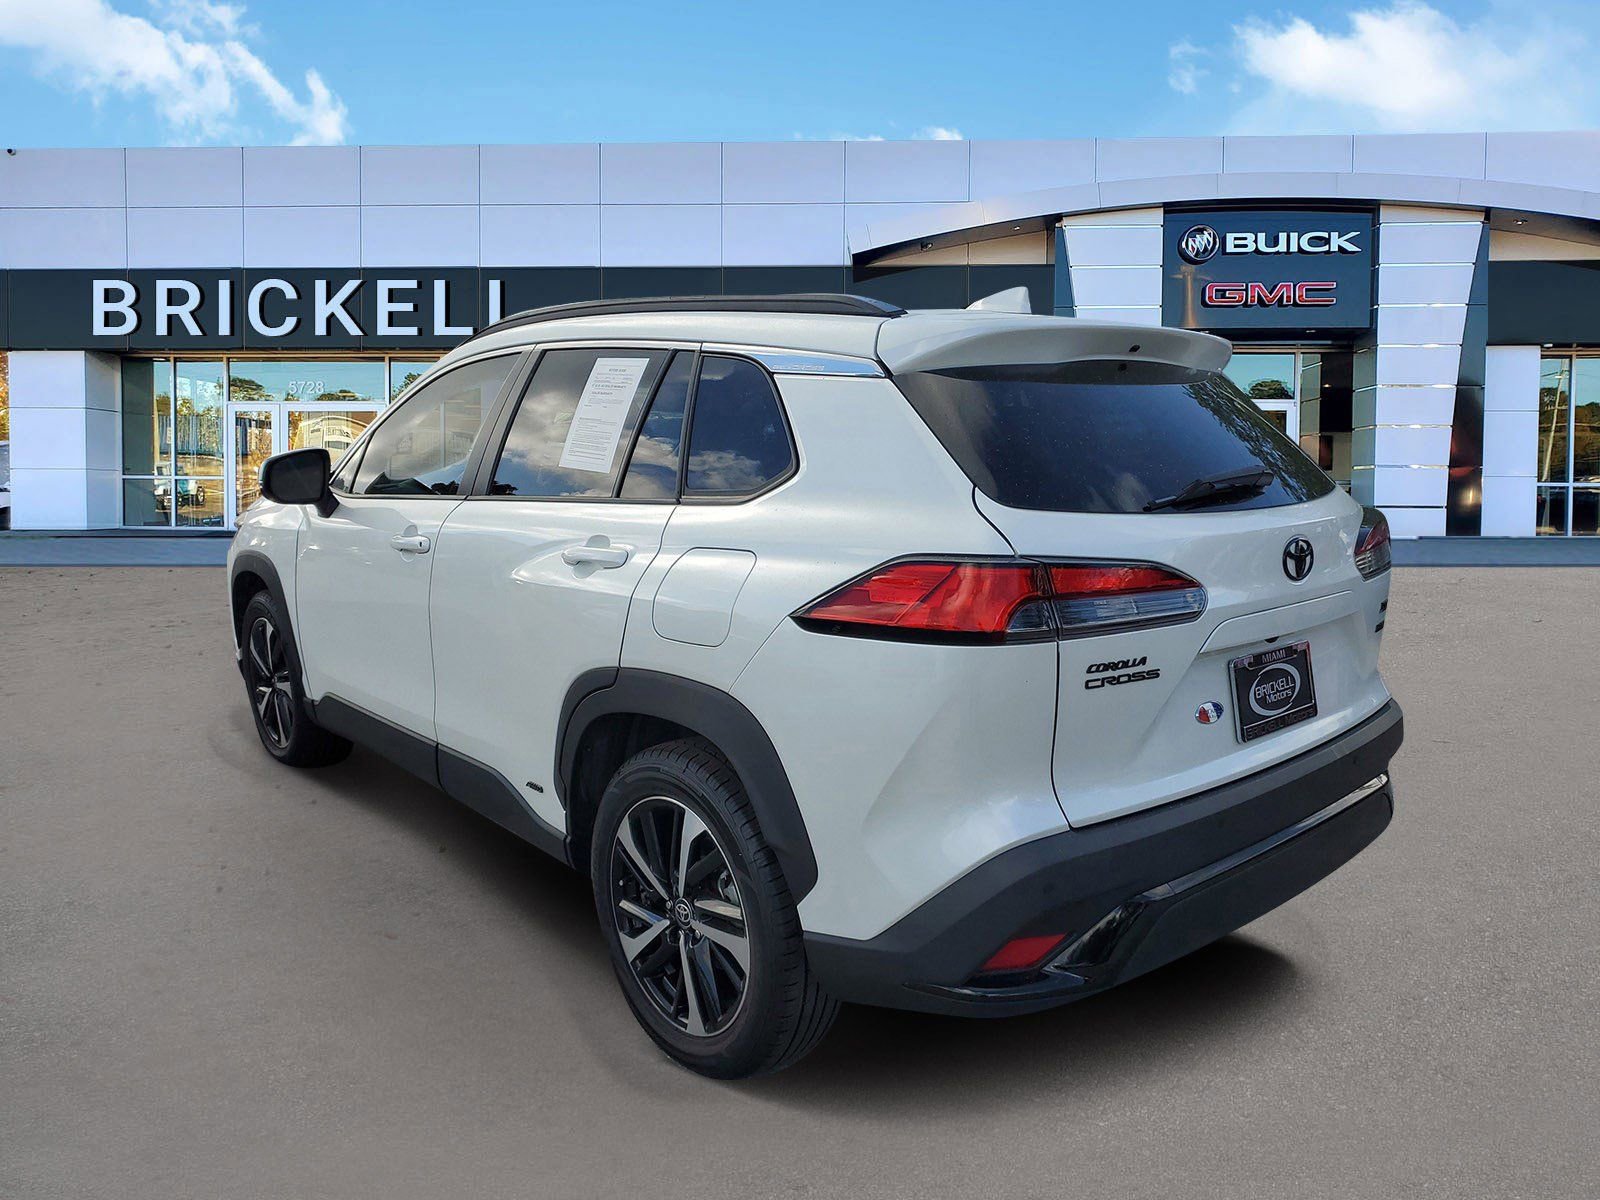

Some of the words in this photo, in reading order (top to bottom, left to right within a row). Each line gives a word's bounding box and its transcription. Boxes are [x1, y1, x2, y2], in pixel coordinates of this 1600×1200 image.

[1225, 231, 1362, 253] BUICK
[1205, 281, 1337, 305] GMC
[289, 380, 325, 394] 5728
[1086, 656, 1148, 674] COROLLA
[1262, 649, 1286, 663] MIAMI
[1085, 668, 1161, 690] CROSS
[1255, 676, 1295, 699] BRICKELL
[1266, 689, 1293, 704] Motors
